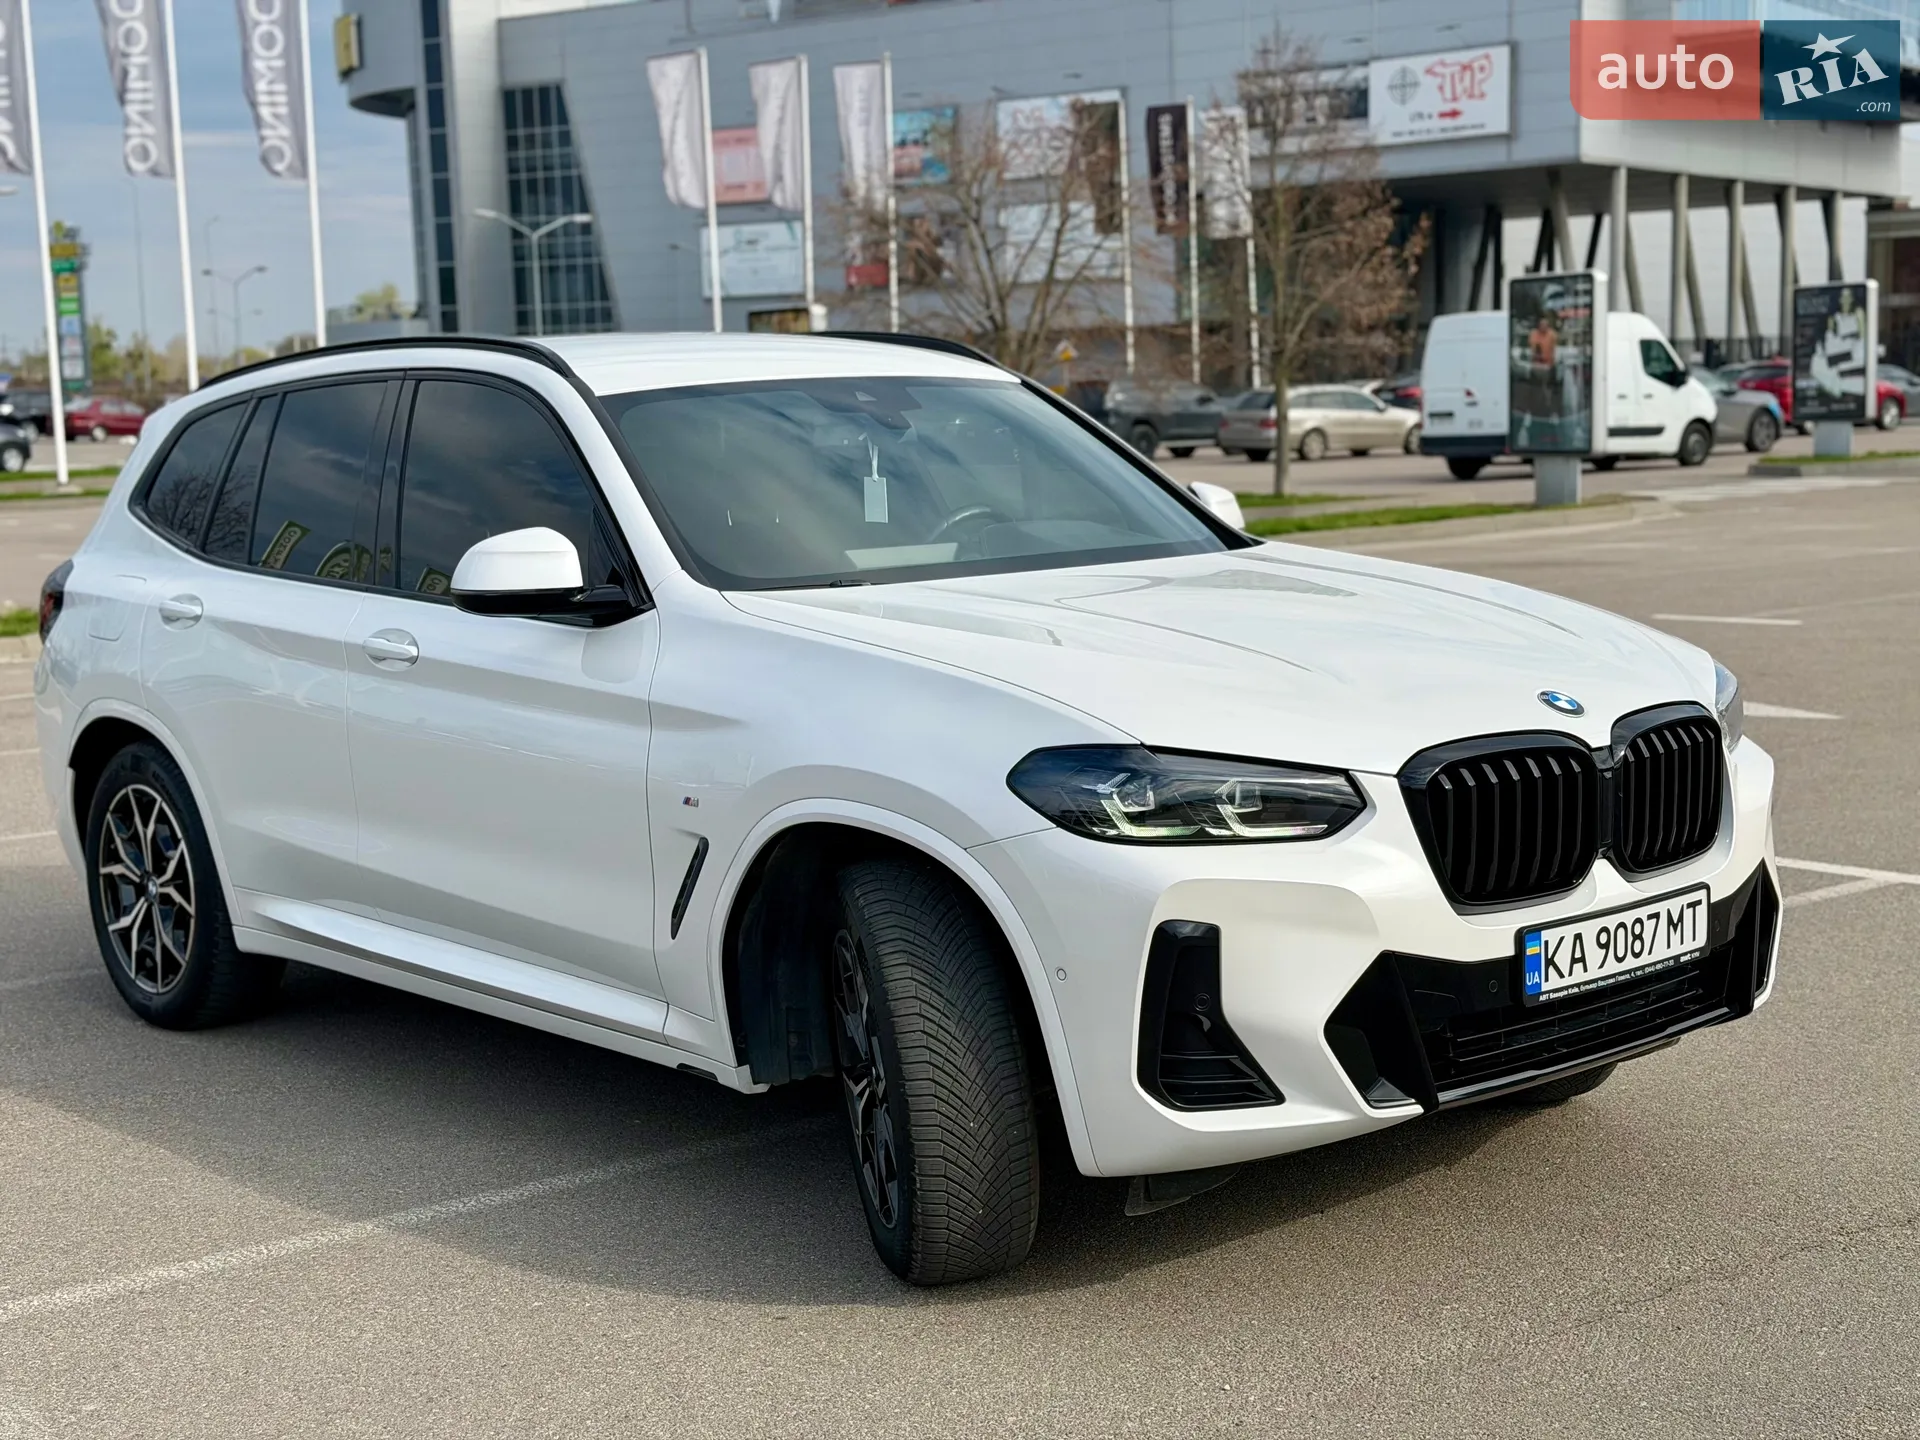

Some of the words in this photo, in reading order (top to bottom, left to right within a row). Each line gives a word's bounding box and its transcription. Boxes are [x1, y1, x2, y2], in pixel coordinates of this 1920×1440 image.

[1544, 932, 1588, 983] KA
[1595, 911, 1661, 970] 9087
[1666, 898, 1702, 949] MT
[1526, 971, 1540, 985] UA
